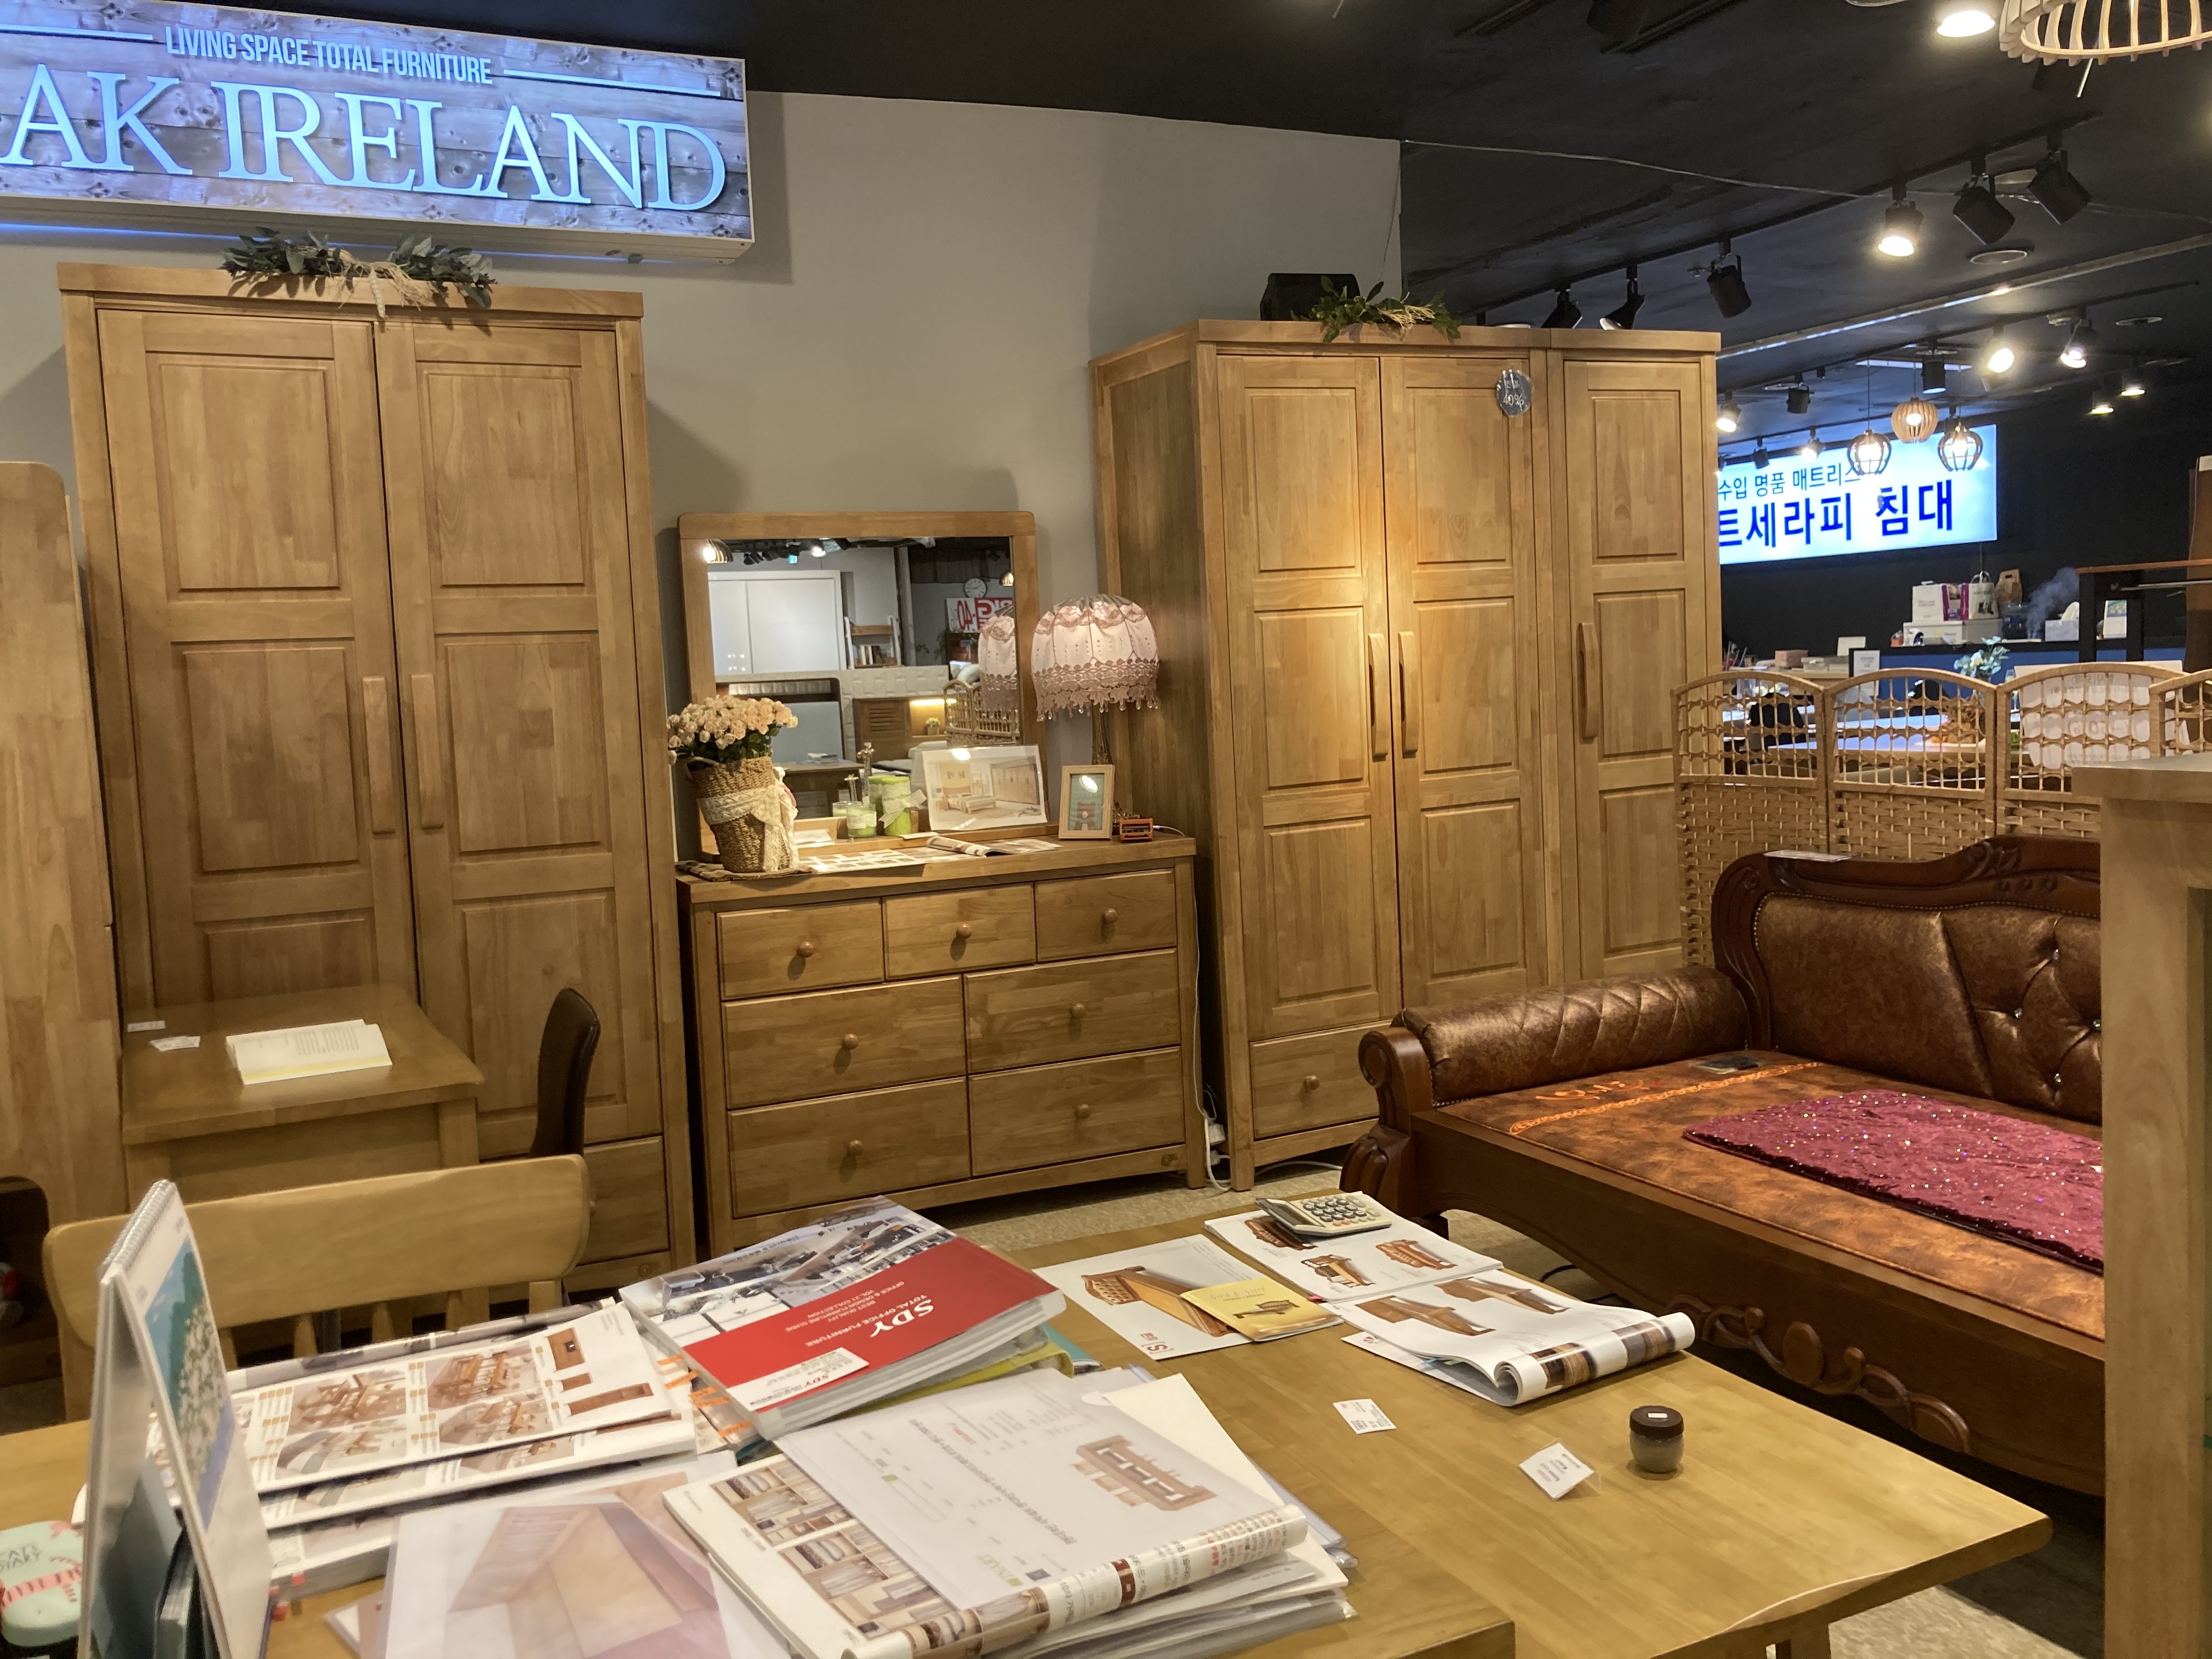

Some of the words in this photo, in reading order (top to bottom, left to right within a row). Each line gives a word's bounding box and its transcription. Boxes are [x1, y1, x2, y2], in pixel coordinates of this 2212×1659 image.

[165, 27, 236, 59] LIVING
[241, 35, 310, 66] SPACE
[313, 41, 381, 73] TOTAL
[381, 48, 493, 84] FURNITURE
[0, 64, 193, 175] AK
[211, 81, 725, 211] IRELAND
[1503, 394, 1524, 406] 40%
[1718, 476, 1747, 501] 수입
[1755, 472, 1785, 497] 명품
[1792, 462, 1860, 492] 매트리스
[1718, 493, 1852, 548] 트세라피
[1875, 479, 1953, 536] 침대
[881, 1280, 905, 1295] OFFICE
[858, 1300, 876, 1311] BEST
[896, 1294, 927, 1310] TOTAL
[828, 1308, 857, 1323] QUALITY
[861, 1308, 896, 1325] OFFICE
[870, 1299, 934, 1338] SDY
[805, 1322, 862, 1347] FURNITURE
[804, 1374, 830, 1388] SDY
